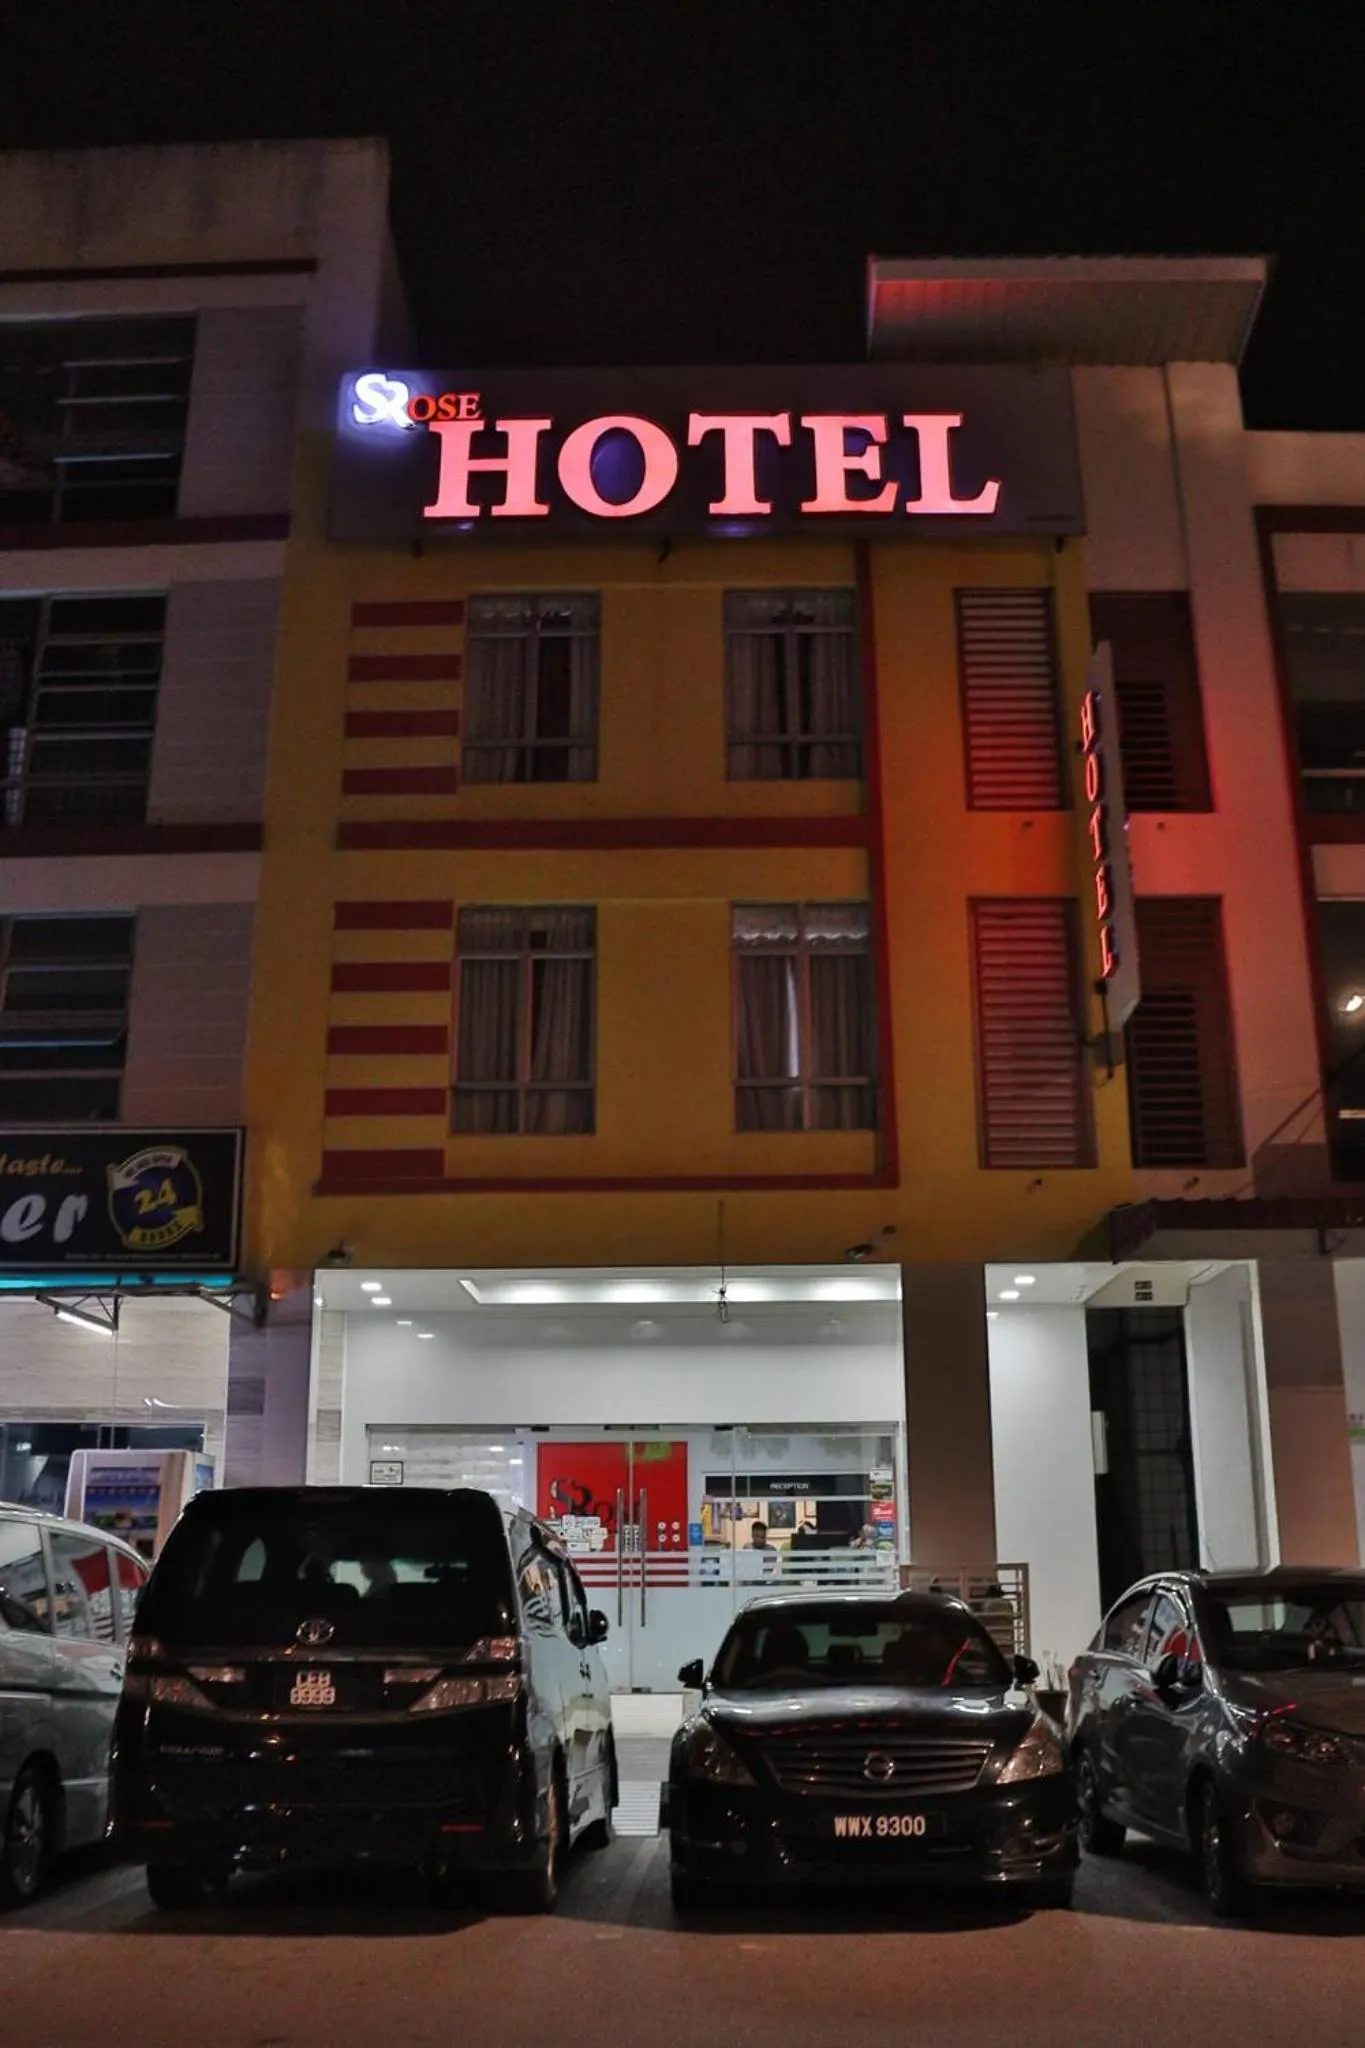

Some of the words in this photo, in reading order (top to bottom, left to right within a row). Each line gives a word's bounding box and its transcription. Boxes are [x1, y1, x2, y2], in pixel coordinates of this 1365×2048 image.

[422, 411, 1001, 520] HOTEL
[1079, 689, 1118, 979] HOTEL
[133, 1176, 177, 1216] 24
[833, 1815, 873, 1837] WWX
[876, 1815, 926, 1837] 9300
